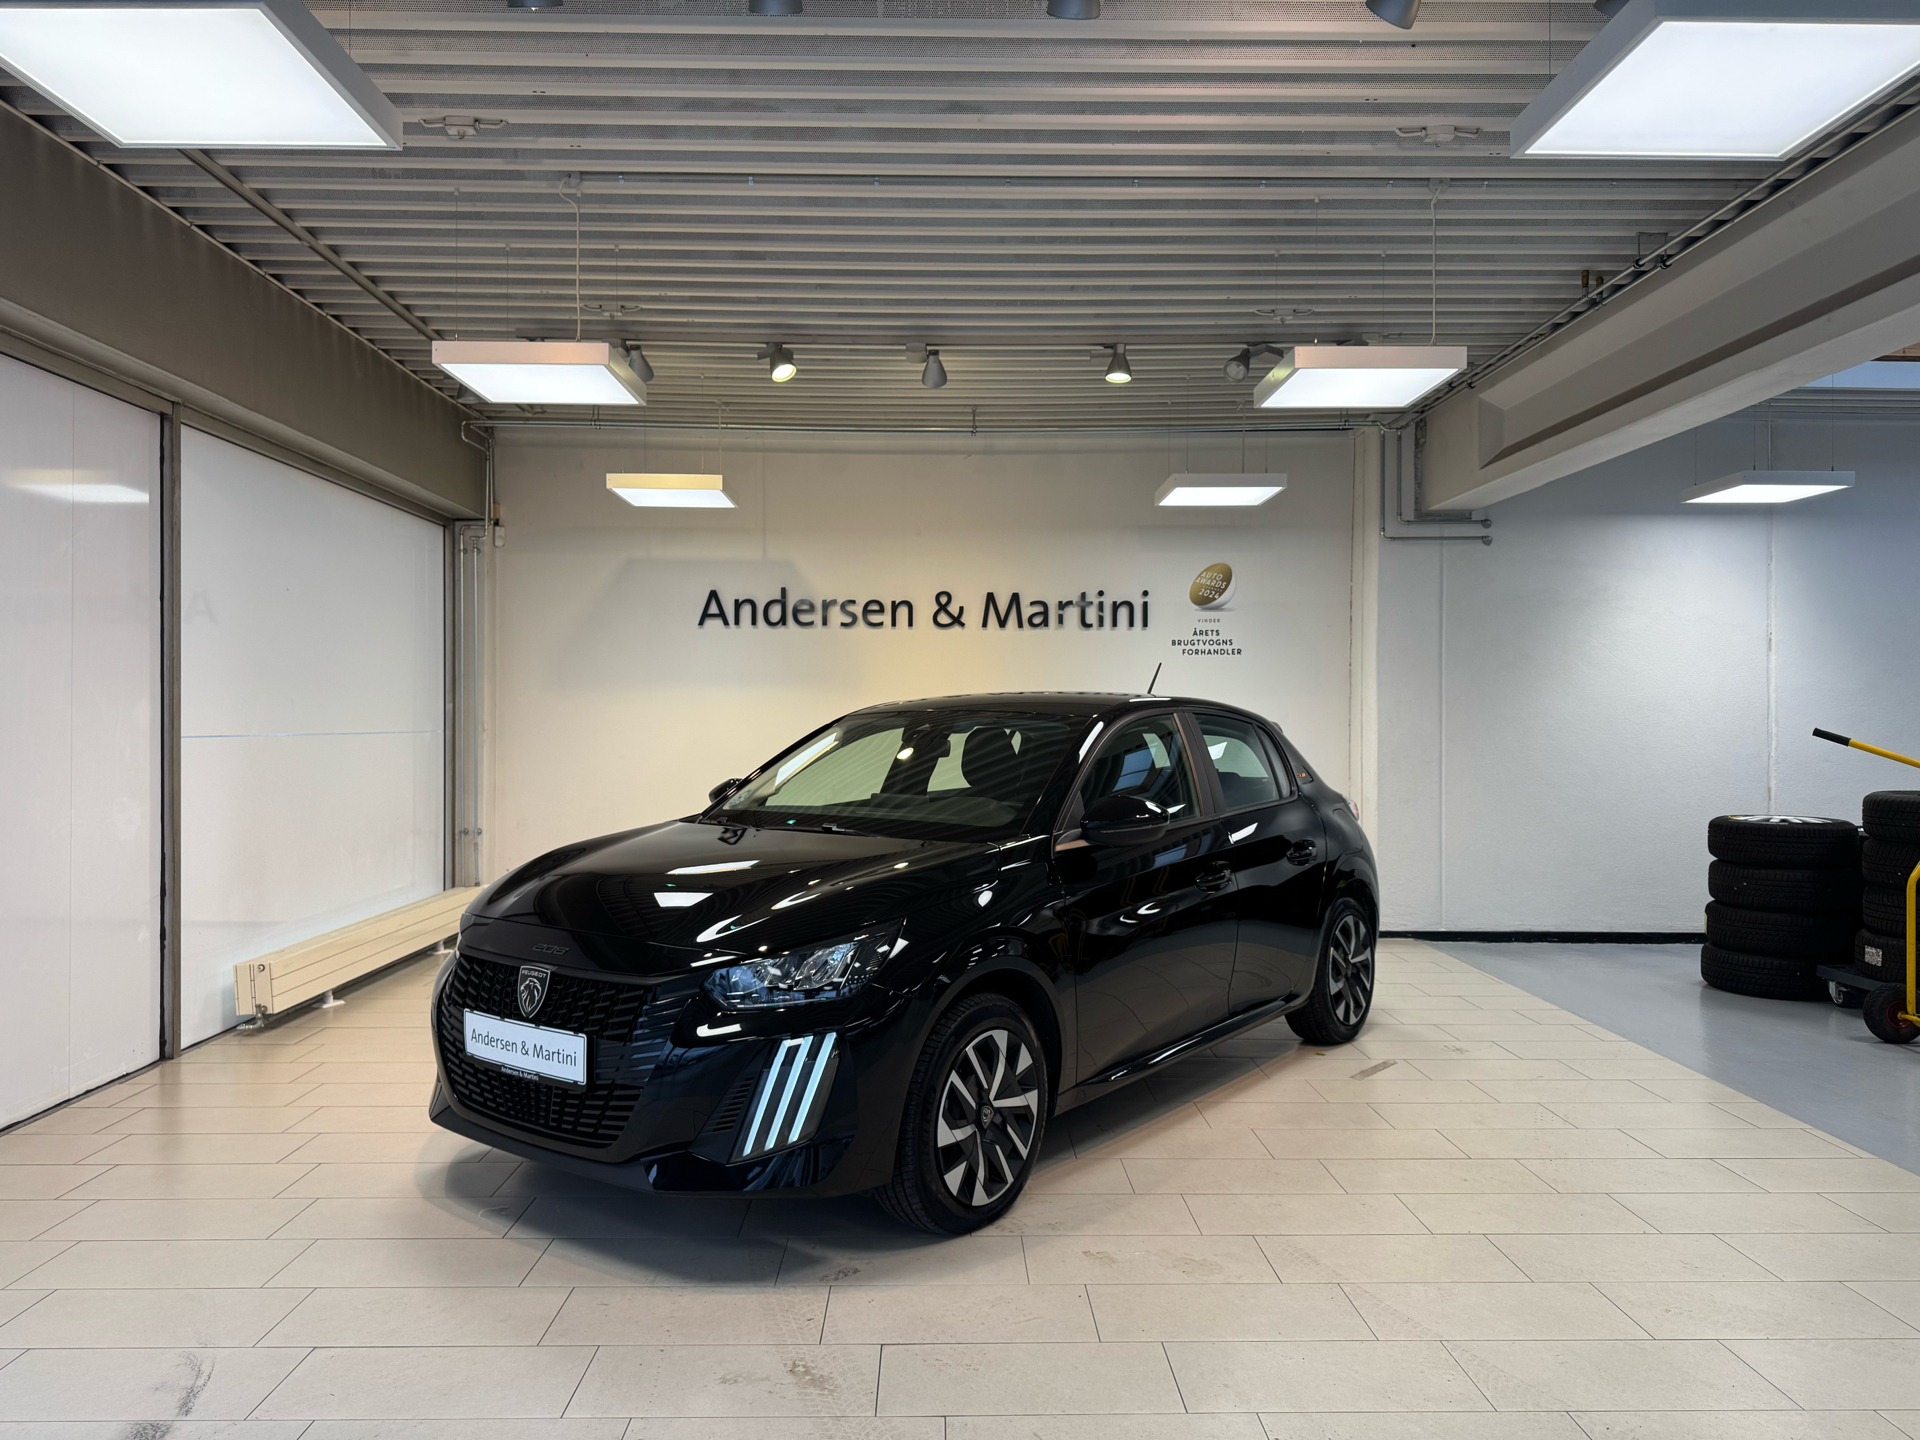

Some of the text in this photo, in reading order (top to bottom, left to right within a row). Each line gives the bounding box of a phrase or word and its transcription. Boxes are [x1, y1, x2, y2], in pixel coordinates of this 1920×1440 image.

[1200, 571, 1223, 581] AUTO
[1195, 577, 1227, 589] AWARDS
[698, 586, 1150, 629] Andersen & Martini
[1192, 627, 1220, 637] ÅRETS
[1171, 639, 1233, 647] BRUGTVOGNS
[1182, 648, 1242, 656] FORHANDLER
[532, 943, 569, 955] 208
[521, 969, 547, 979] PEUGEOT
[471, 1028, 577, 1067] Andersen & Martini
